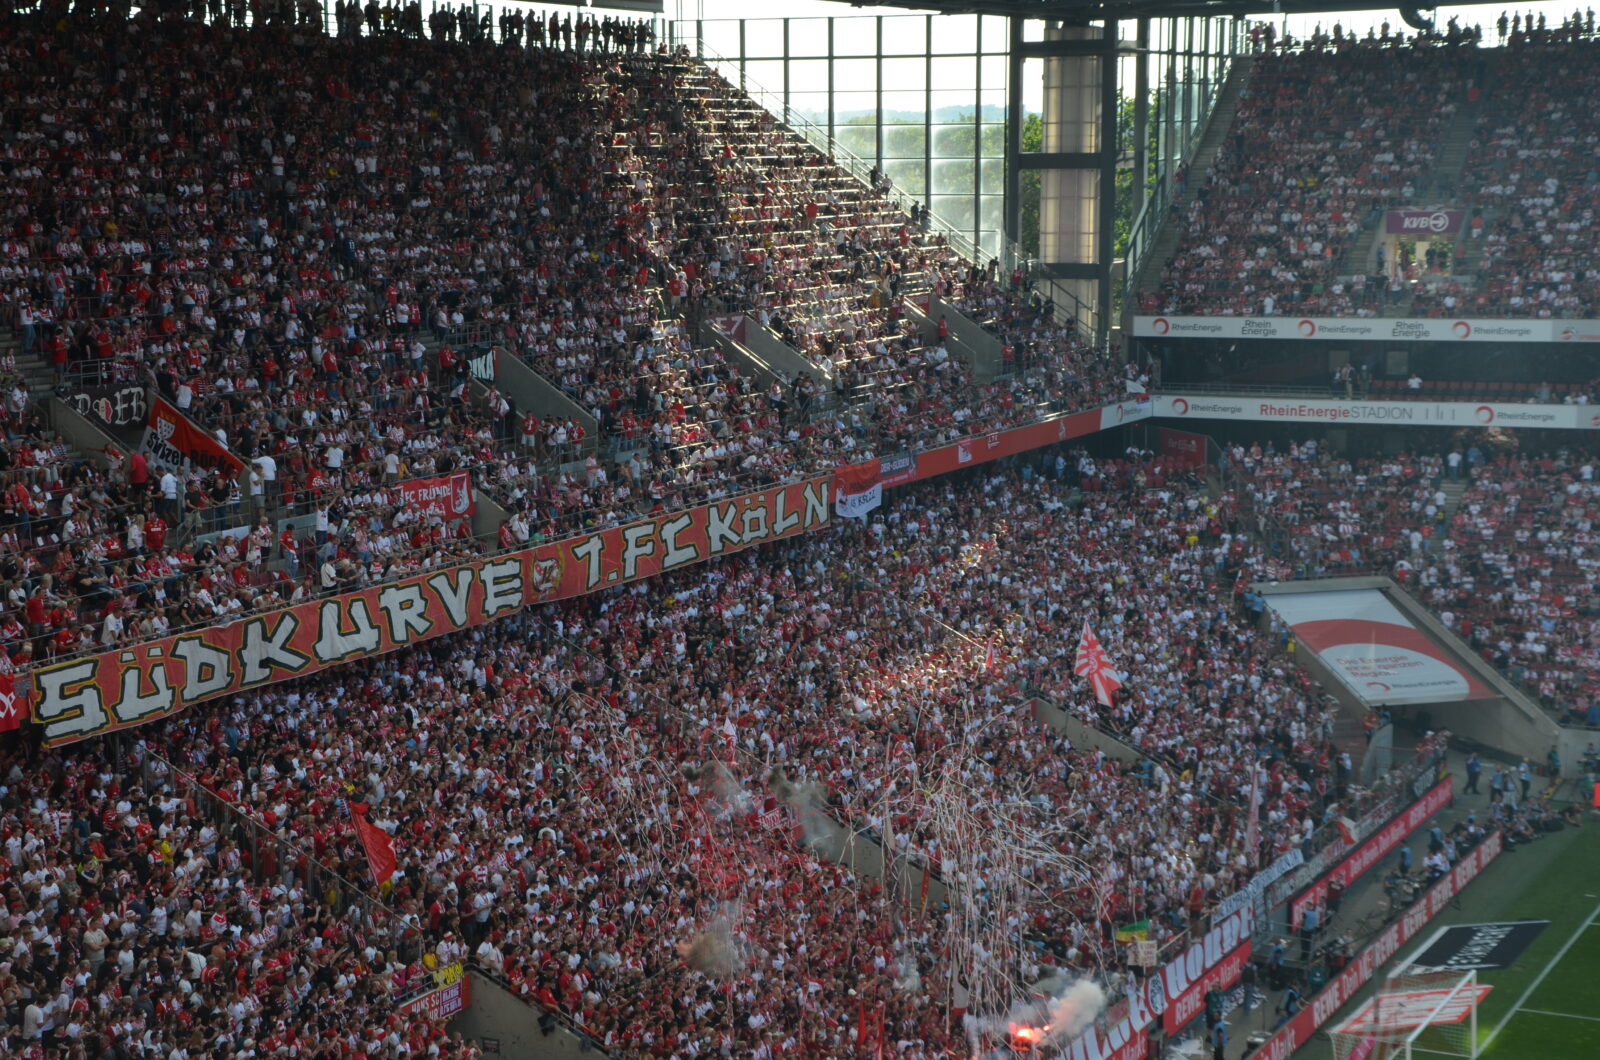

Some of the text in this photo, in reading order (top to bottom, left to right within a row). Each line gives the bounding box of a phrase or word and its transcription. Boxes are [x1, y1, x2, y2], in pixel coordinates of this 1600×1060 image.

[1403, 217, 1430, 229] KVB
[1171, 322, 1223, 333] RheinEnergie
[1245, 320, 1271, 329] Rhein
[1318, 325, 1372, 335] RheinEnergie
[1396, 321, 1424, 329] Rhein
[1241, 327, 1277, 337] Energie
[1392, 328, 1430, 339] Energie
[1473, 326, 1531, 337] RheinEnergie
[1191, 403, 1242, 414] RheinEnergie
[1260, 403, 1413, 420] RheinEnergieSTADION
[1497, 411, 1555, 422] RheinEnergie
[404, 490, 416, 503] FC
[36, 558, 523, 738] SÜDKURVE
[705, 481, 830, 556] KÖLN
[1312, 982, 1341, 1028] REWE
[1342, 967, 1358, 998] Dein
[1175, 986, 1201, 1025] REWE
